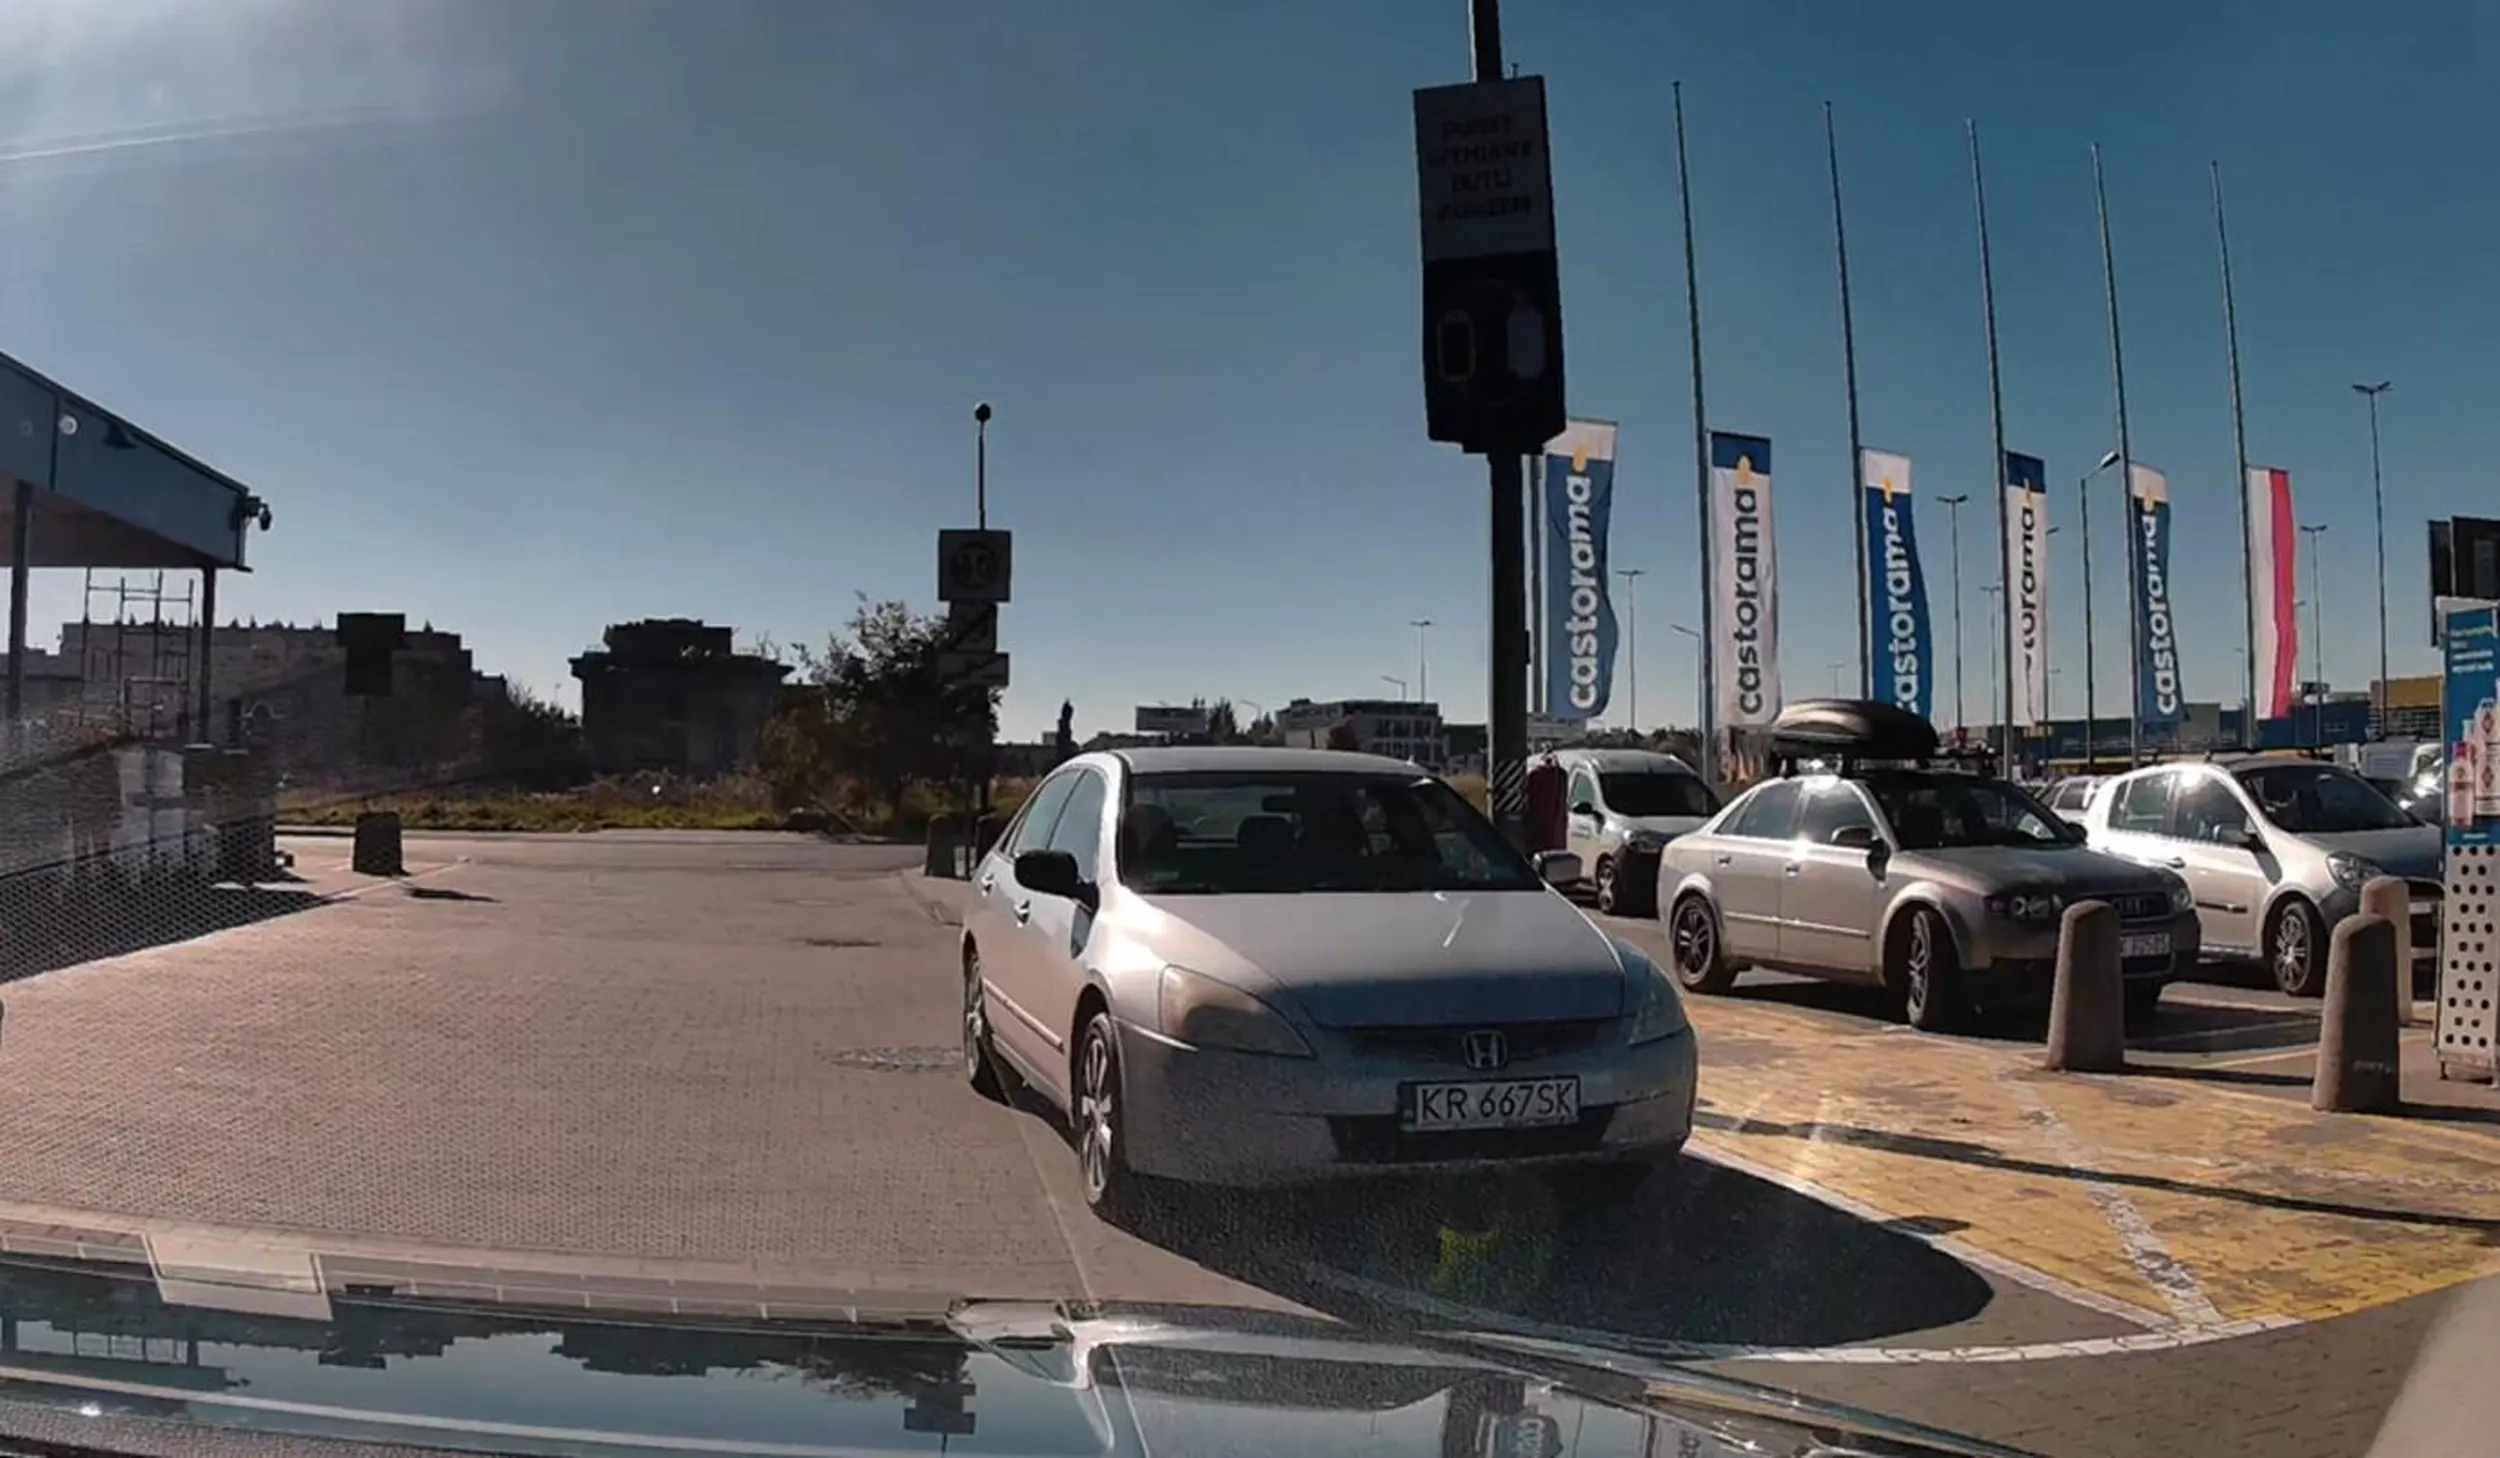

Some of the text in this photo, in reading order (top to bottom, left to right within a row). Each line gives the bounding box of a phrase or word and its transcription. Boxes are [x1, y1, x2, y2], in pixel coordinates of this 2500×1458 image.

[1565, 474, 1599, 710] castorama
[1733, 488, 1760, 715] castorama
[2141, 514, 2178, 715] castorama
[1421, 1081, 1576, 1121] KR 667SK
